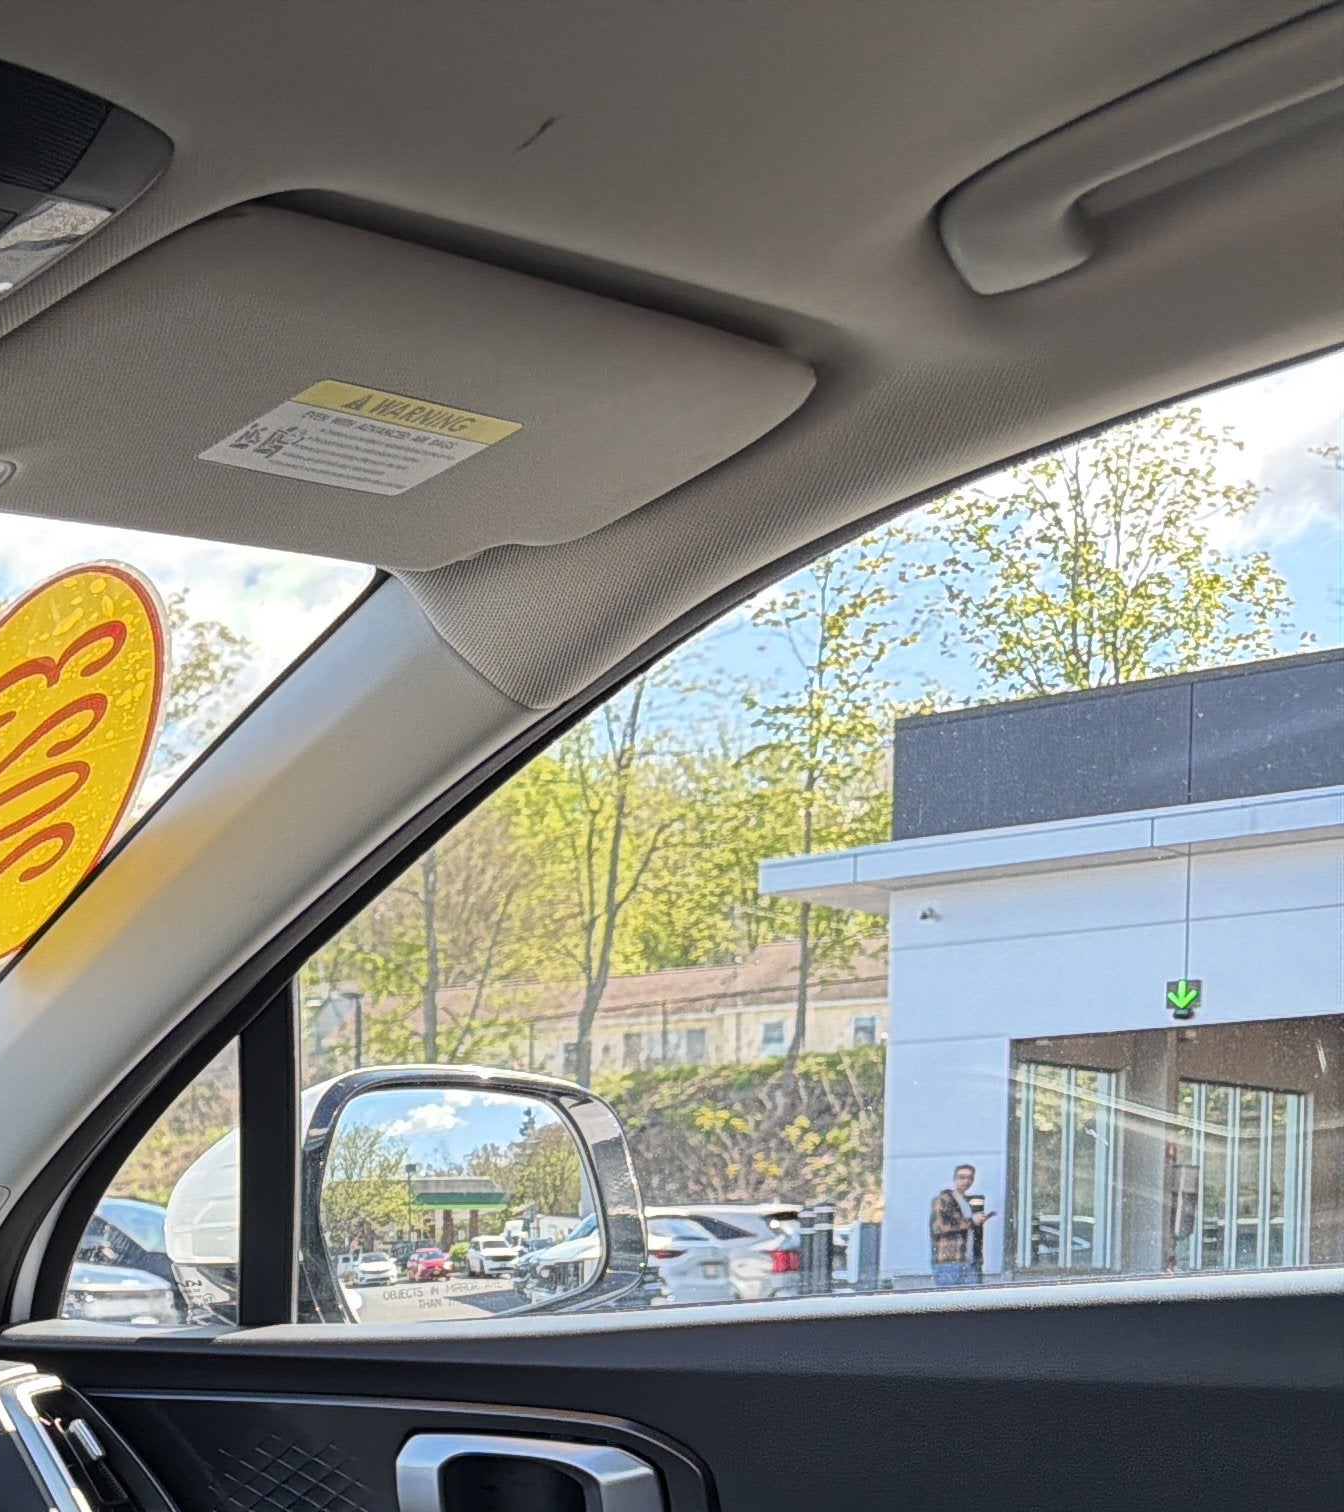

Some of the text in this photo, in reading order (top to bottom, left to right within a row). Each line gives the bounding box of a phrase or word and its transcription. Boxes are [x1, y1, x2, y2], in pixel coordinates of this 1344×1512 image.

[369, 397, 477, 432] WARNING
[382, 1286, 424, 1301] OBJECTS
[430, 1286, 440, 1296] IN
[446, 1281, 479, 1293] MIRROR
[418, 1298, 442, 1309] THAN
